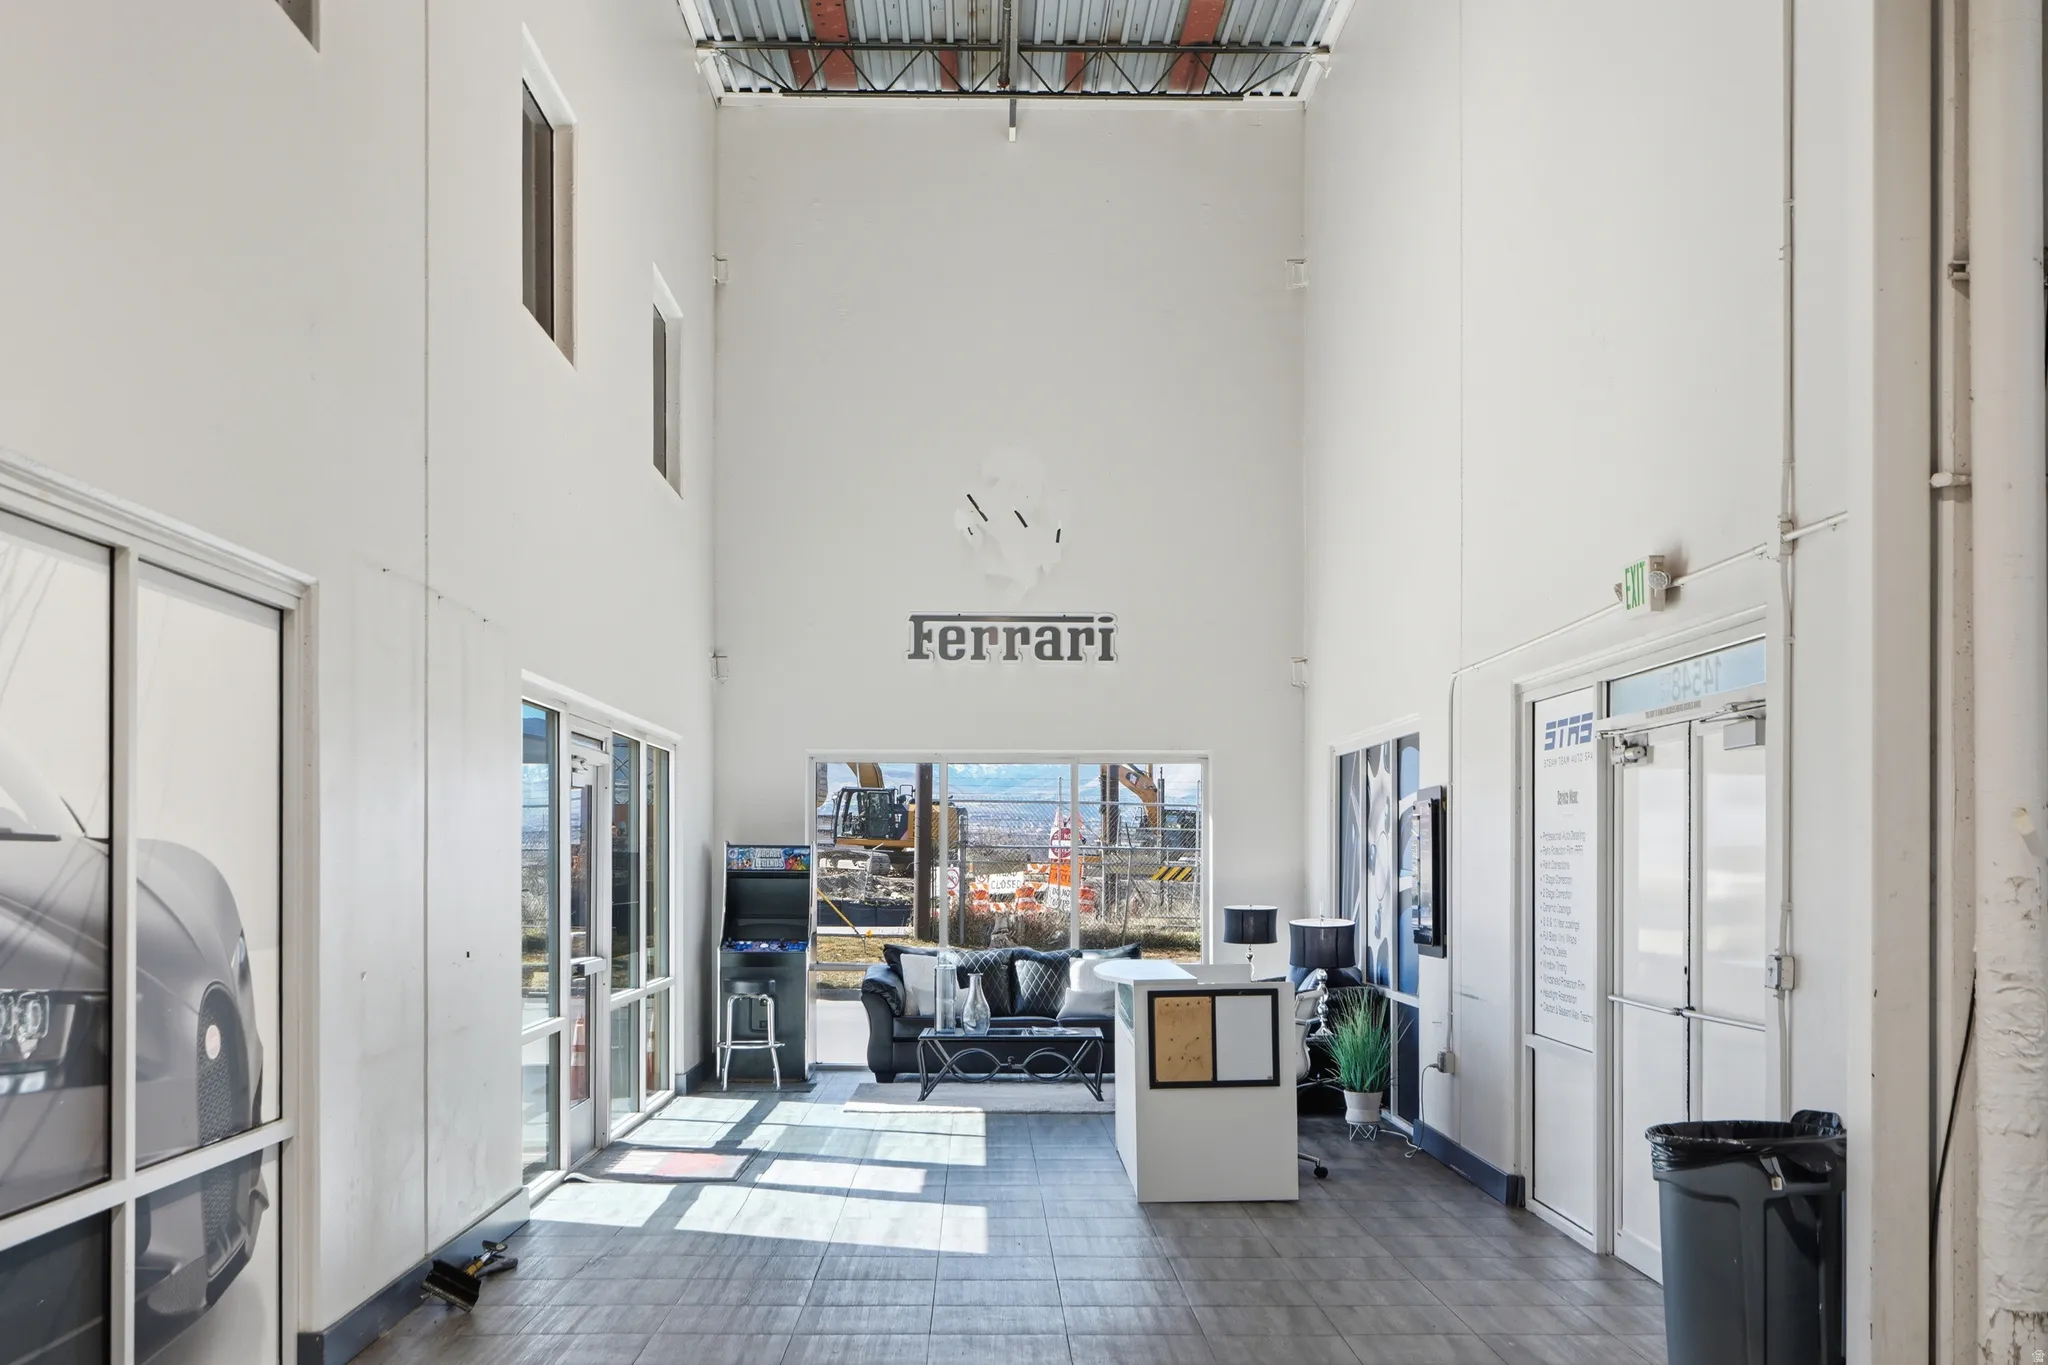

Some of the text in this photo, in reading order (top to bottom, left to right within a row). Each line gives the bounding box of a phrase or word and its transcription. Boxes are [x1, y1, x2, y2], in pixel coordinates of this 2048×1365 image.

[1625, 561, 1645, 610] EXIT
[907, 614, 1114, 661] Ferrari
[1544, 712, 1593, 750] STAS
[990, 879, 1021, 890] CLOSED
